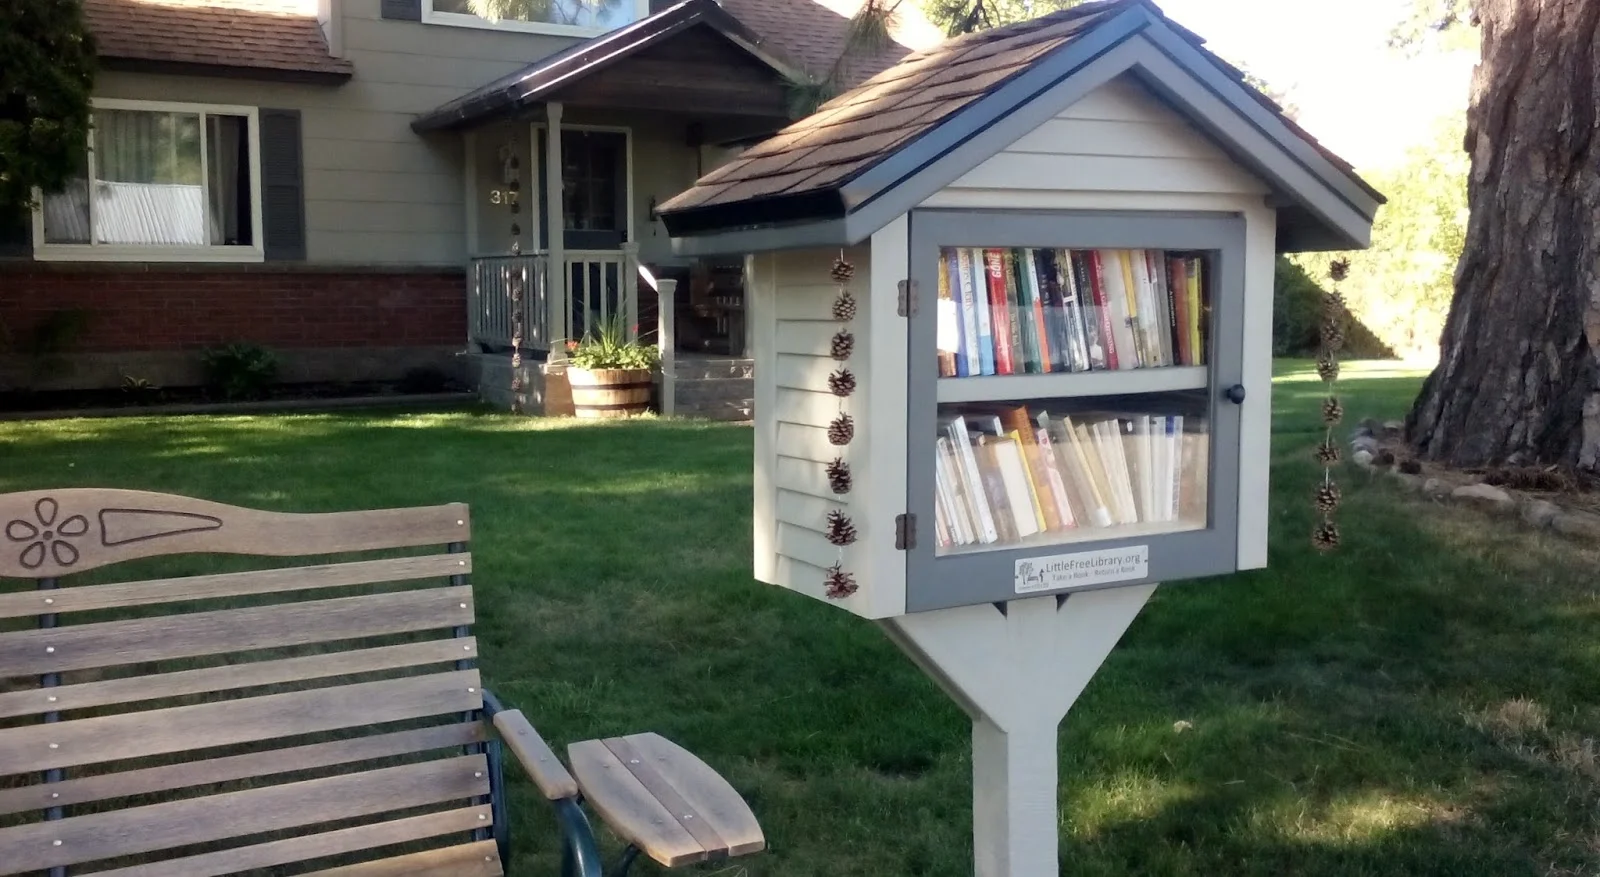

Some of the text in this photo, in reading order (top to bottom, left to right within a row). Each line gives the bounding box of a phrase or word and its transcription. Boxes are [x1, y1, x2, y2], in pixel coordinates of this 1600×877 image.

[491, 190, 518, 204] 317
[989, 251, 1002, 278] GONE
[1046, 555, 1140, 573] LittleFreeLibrary.org
